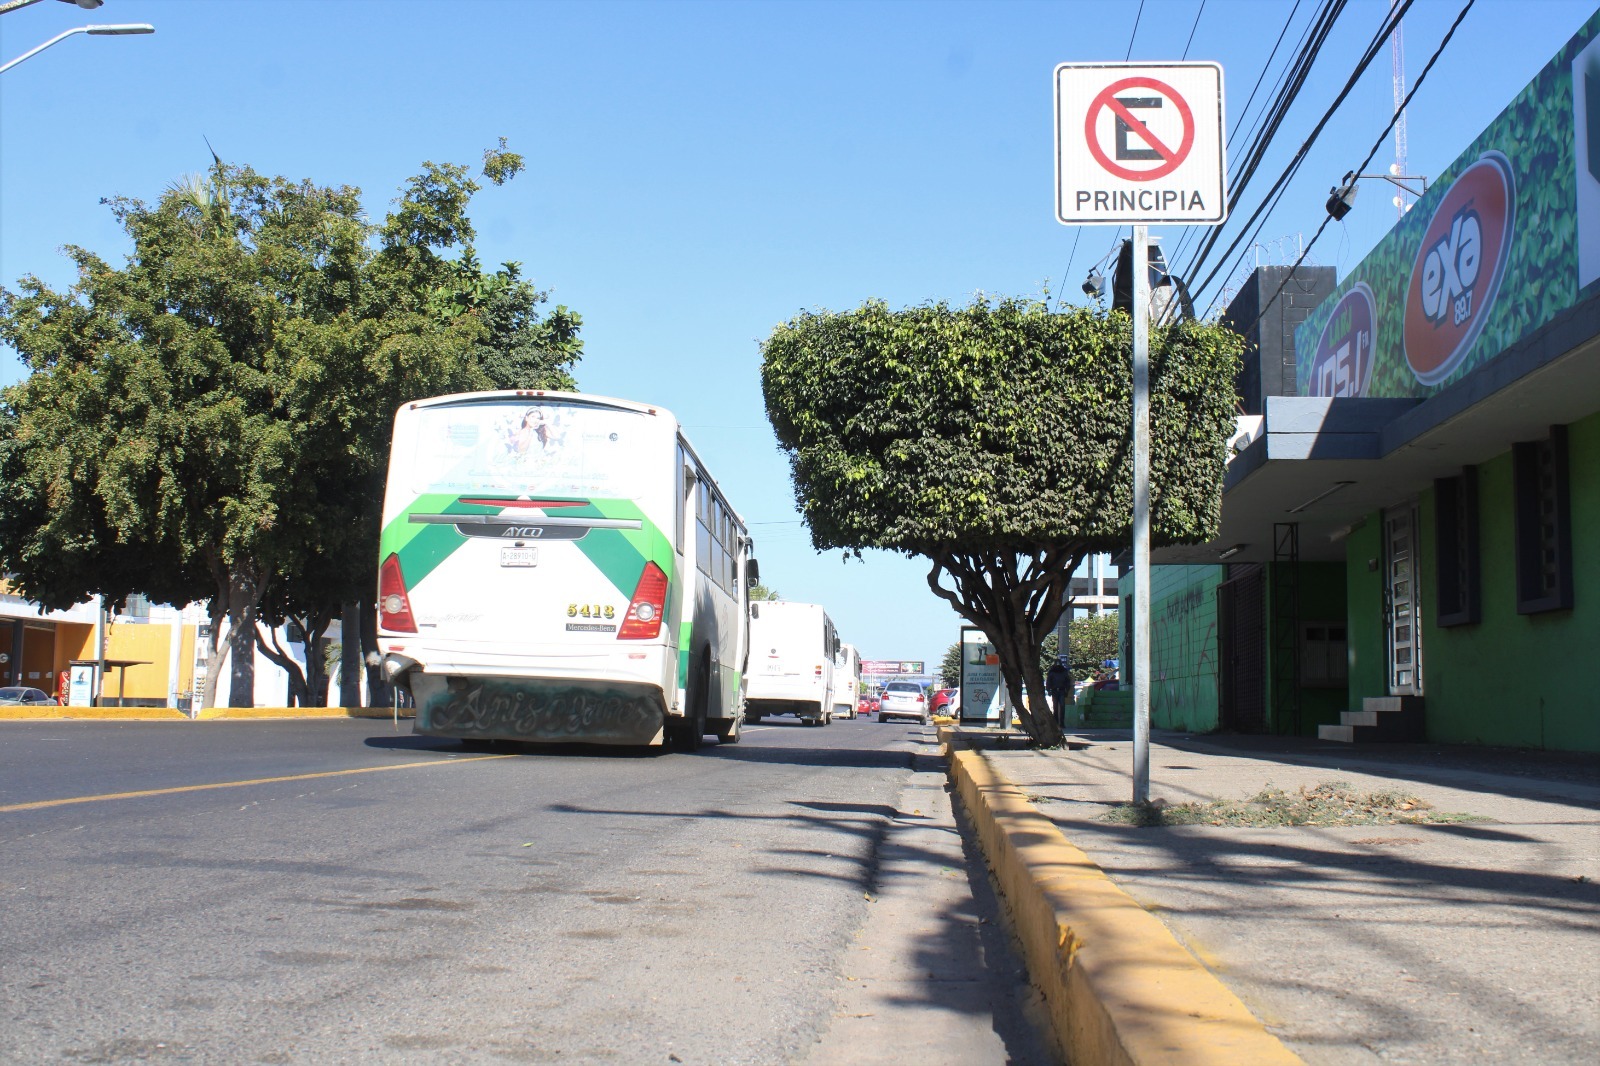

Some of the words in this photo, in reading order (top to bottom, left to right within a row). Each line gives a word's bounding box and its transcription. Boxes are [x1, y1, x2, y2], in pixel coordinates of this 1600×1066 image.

[1115, 97, 1165, 160] E
[1076, 190, 1205, 211] PRINCIPIA
[1454, 289, 1473, 326] 89.7
[501, 526, 544, 538] AYCO
[567, 624, 615, 632] Mercedes-Benz
